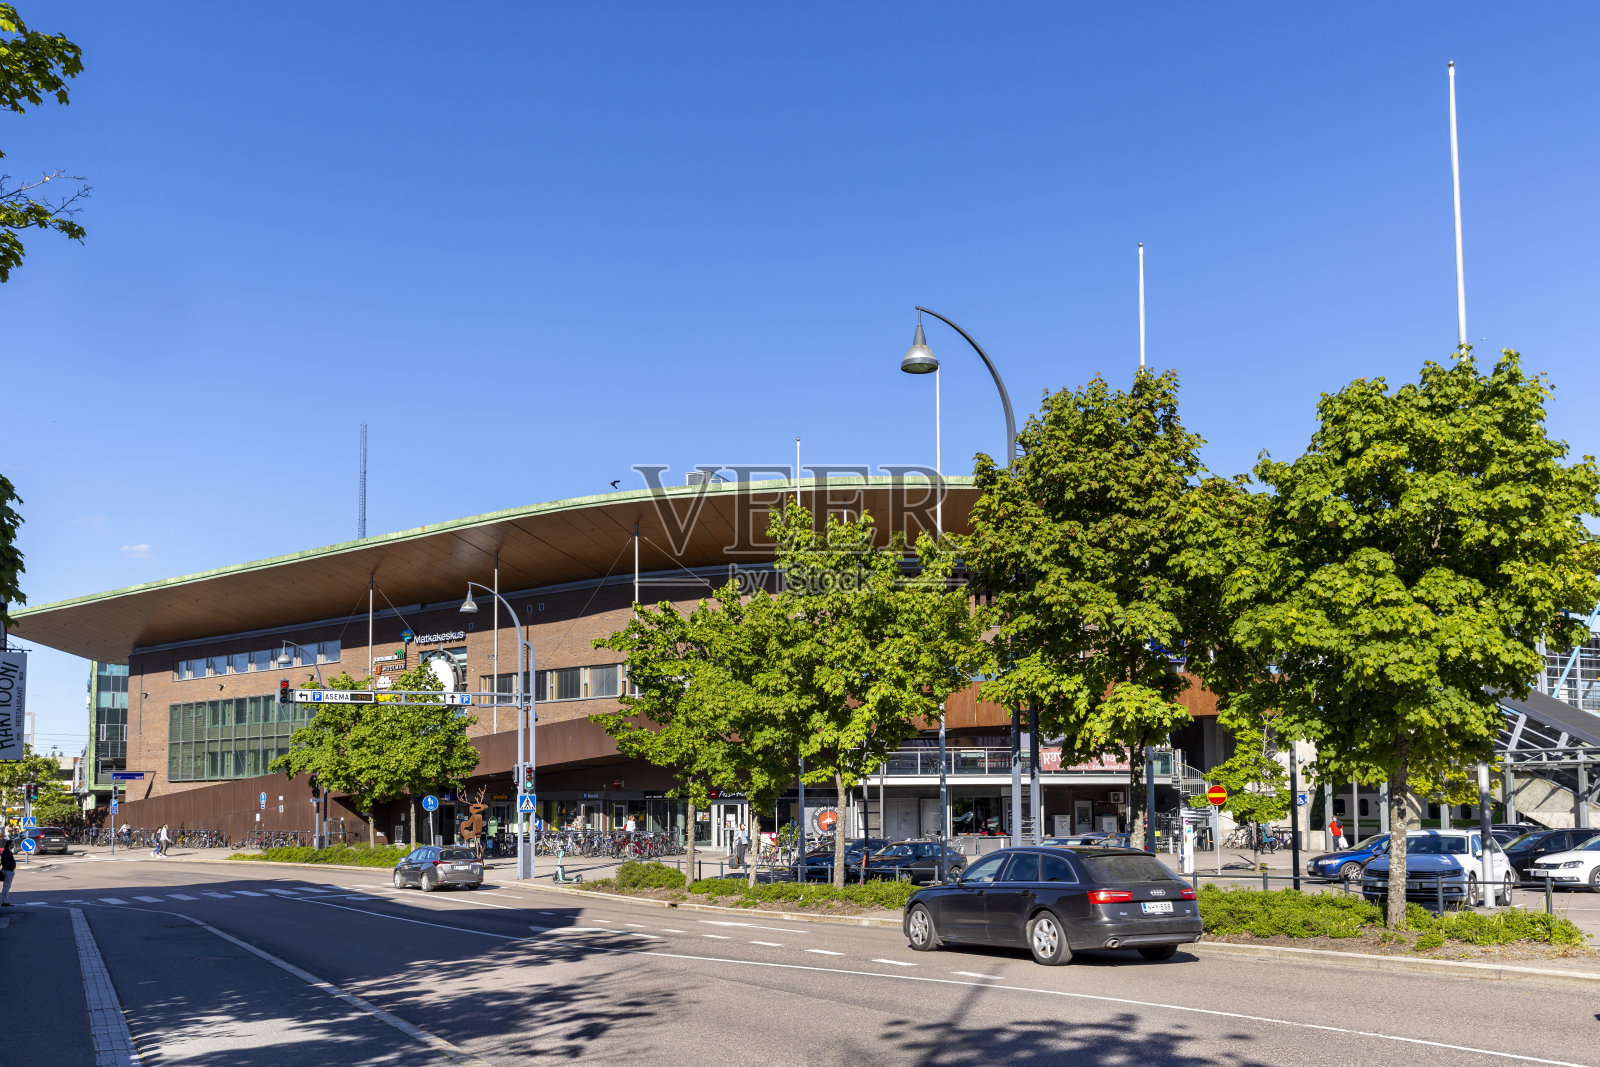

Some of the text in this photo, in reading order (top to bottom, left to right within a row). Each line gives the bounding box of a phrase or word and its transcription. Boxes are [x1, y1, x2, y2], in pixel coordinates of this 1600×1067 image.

[413, 631, 466, 645] Matkakeskus
[324, 693, 350, 701] ASEMA
[15, 686, 24, 727] RESTAURANT
